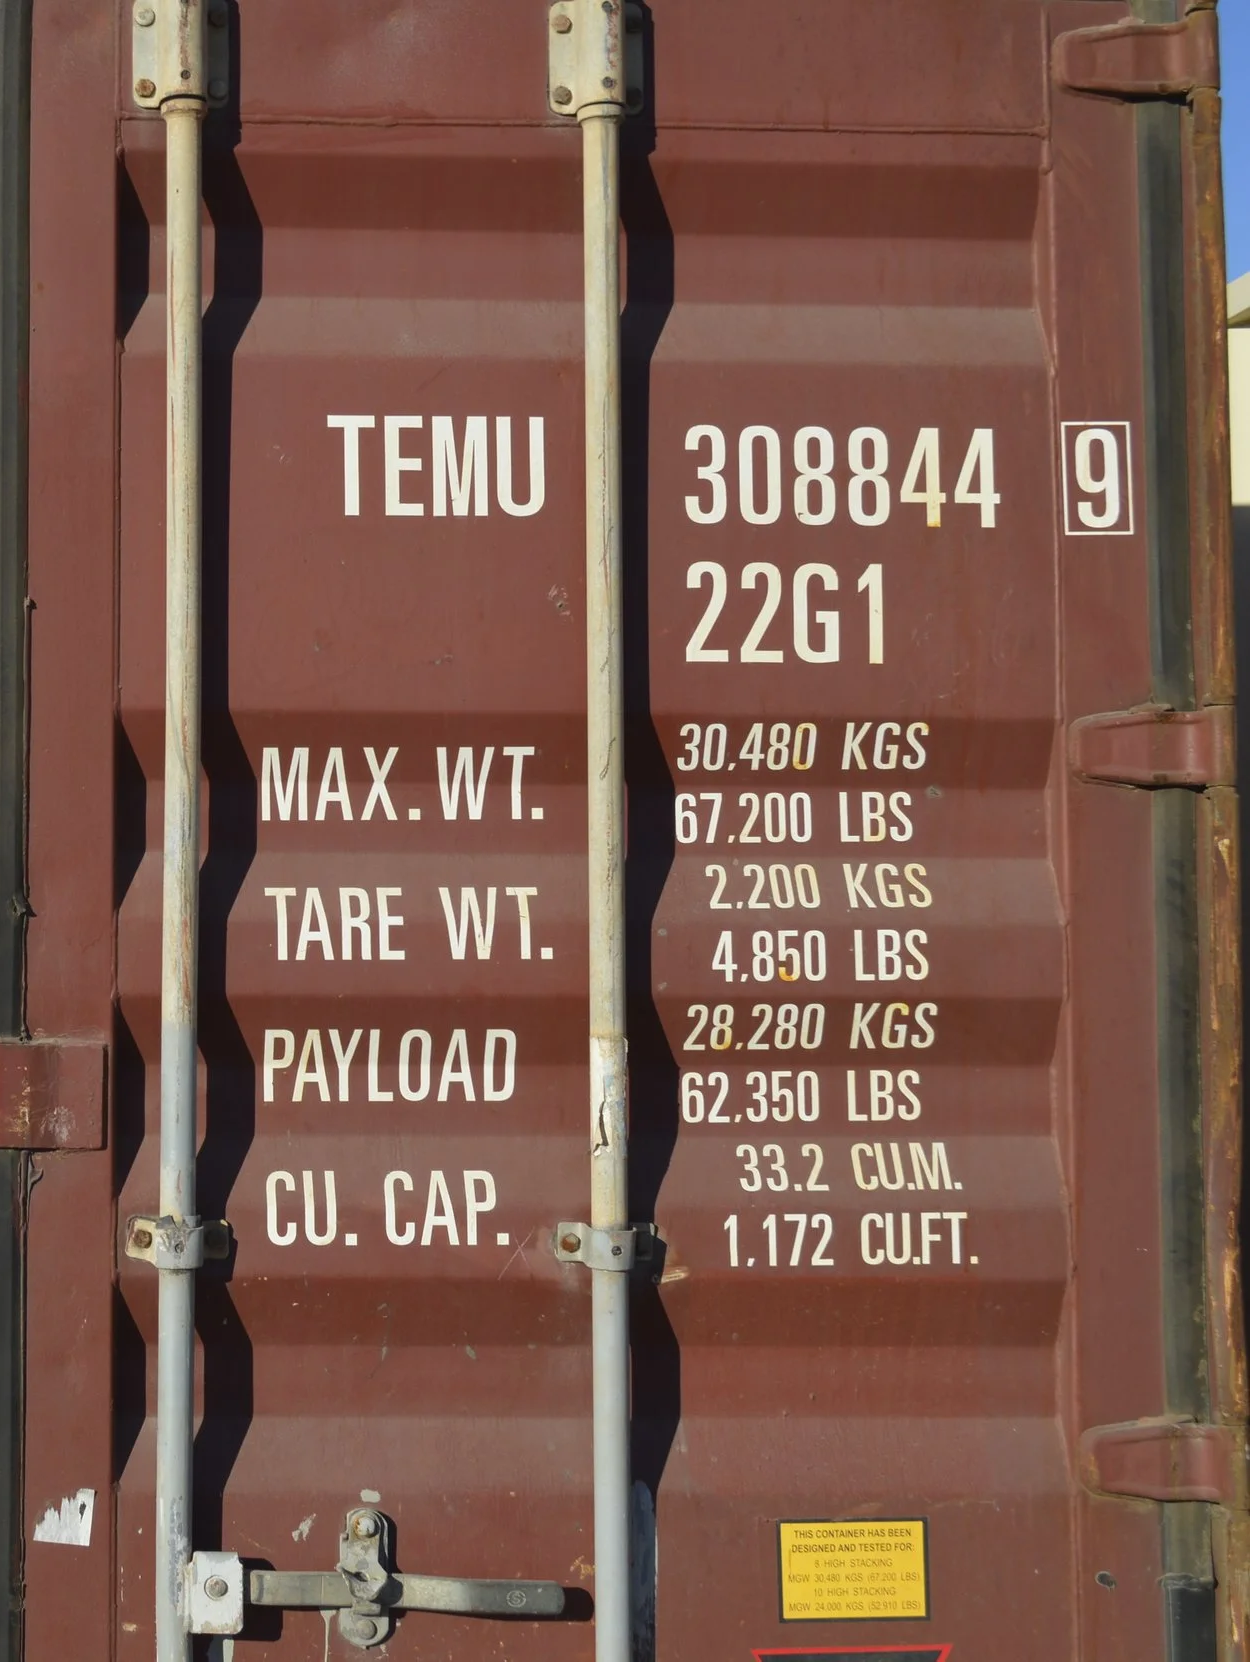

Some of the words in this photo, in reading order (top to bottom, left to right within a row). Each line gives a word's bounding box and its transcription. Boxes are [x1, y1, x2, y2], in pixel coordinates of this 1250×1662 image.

[327, 415, 547, 518] TEMU
[685, 425, 1002, 530] 308844
[1074, 428, 1122, 529] 9
[686, 561, 885, 666] 22G1
[842, 723, 930, 771] KGS
[262, 747, 422, 823] MAX.
[437, 747, 545, 822] WT.
[839, 792, 915, 844] LBS
[843, 863, 934, 910] KGS
[264, 887, 407, 962] TARE
[438, 887, 555, 961] WT.
[854, 929, 930, 983] LBS
[850, 1003, 939, 1050] KGS
[264, 1029, 518, 1104] PAYLOAD
[847, 1070, 923, 1123] LBS
[736, 1144, 831, 1193] 33.2
[851, 1142, 964, 1192] CU.M.
[266, 1171, 359, 1248] CU.
[384, 1170, 511, 1247] CAP.
[861, 1212, 980, 1267] CU.FT.
[791, 1543, 837, 1554] DESIGNED
[837, 1543, 857, 1553] AND
[858, 1542, 893, 1553] TESTED
[893, 1542, 916, 1552] FOR:
[793, 1529, 814, 1540] THIS
[815, 1528, 866, 1539] CONTAINER
[867, 1528, 887, 1539] HAS
[887, 1528, 912, 1538] BEEN
[788, 1573, 811, 1584] MGW
[844, 1572, 864, 1583] KGS
[900, 1571, 921, 1582] LBS)
[823, 1558, 846, 1569] HIGH
[848, 1557, 894, 1568] STACKING
[788, 1602, 811, 1613] MGW
[845, 1601, 865, 1611] KGS
[901, 1600, 921, 1611] LBS)
[813, 1587, 823, 1597] 10
[826, 1587, 850, 1597] HIGH
[852, 1586, 897, 1597] STACKING
